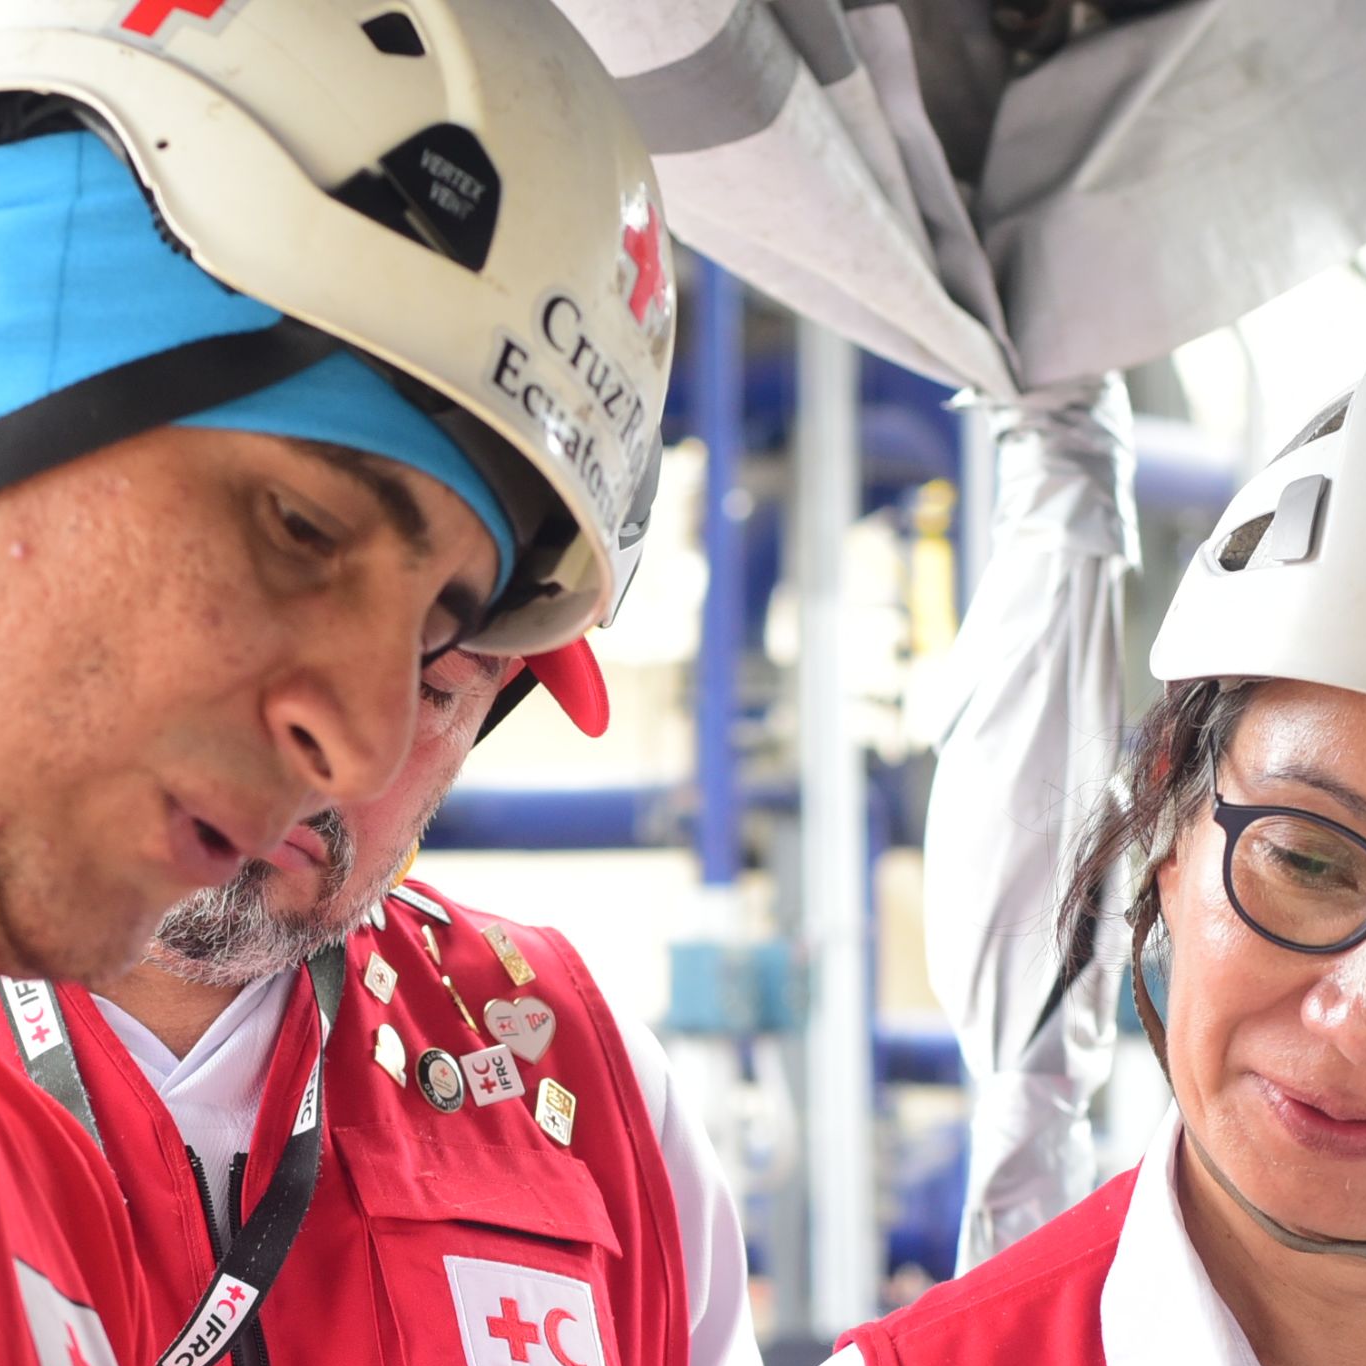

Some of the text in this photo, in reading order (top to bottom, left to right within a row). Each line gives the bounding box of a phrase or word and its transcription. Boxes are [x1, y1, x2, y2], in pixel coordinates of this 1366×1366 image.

[542, 296, 627, 419] Cruz
[15, 983, 39, 1006] IF
[492, 1055, 512, 1091] IFRC
